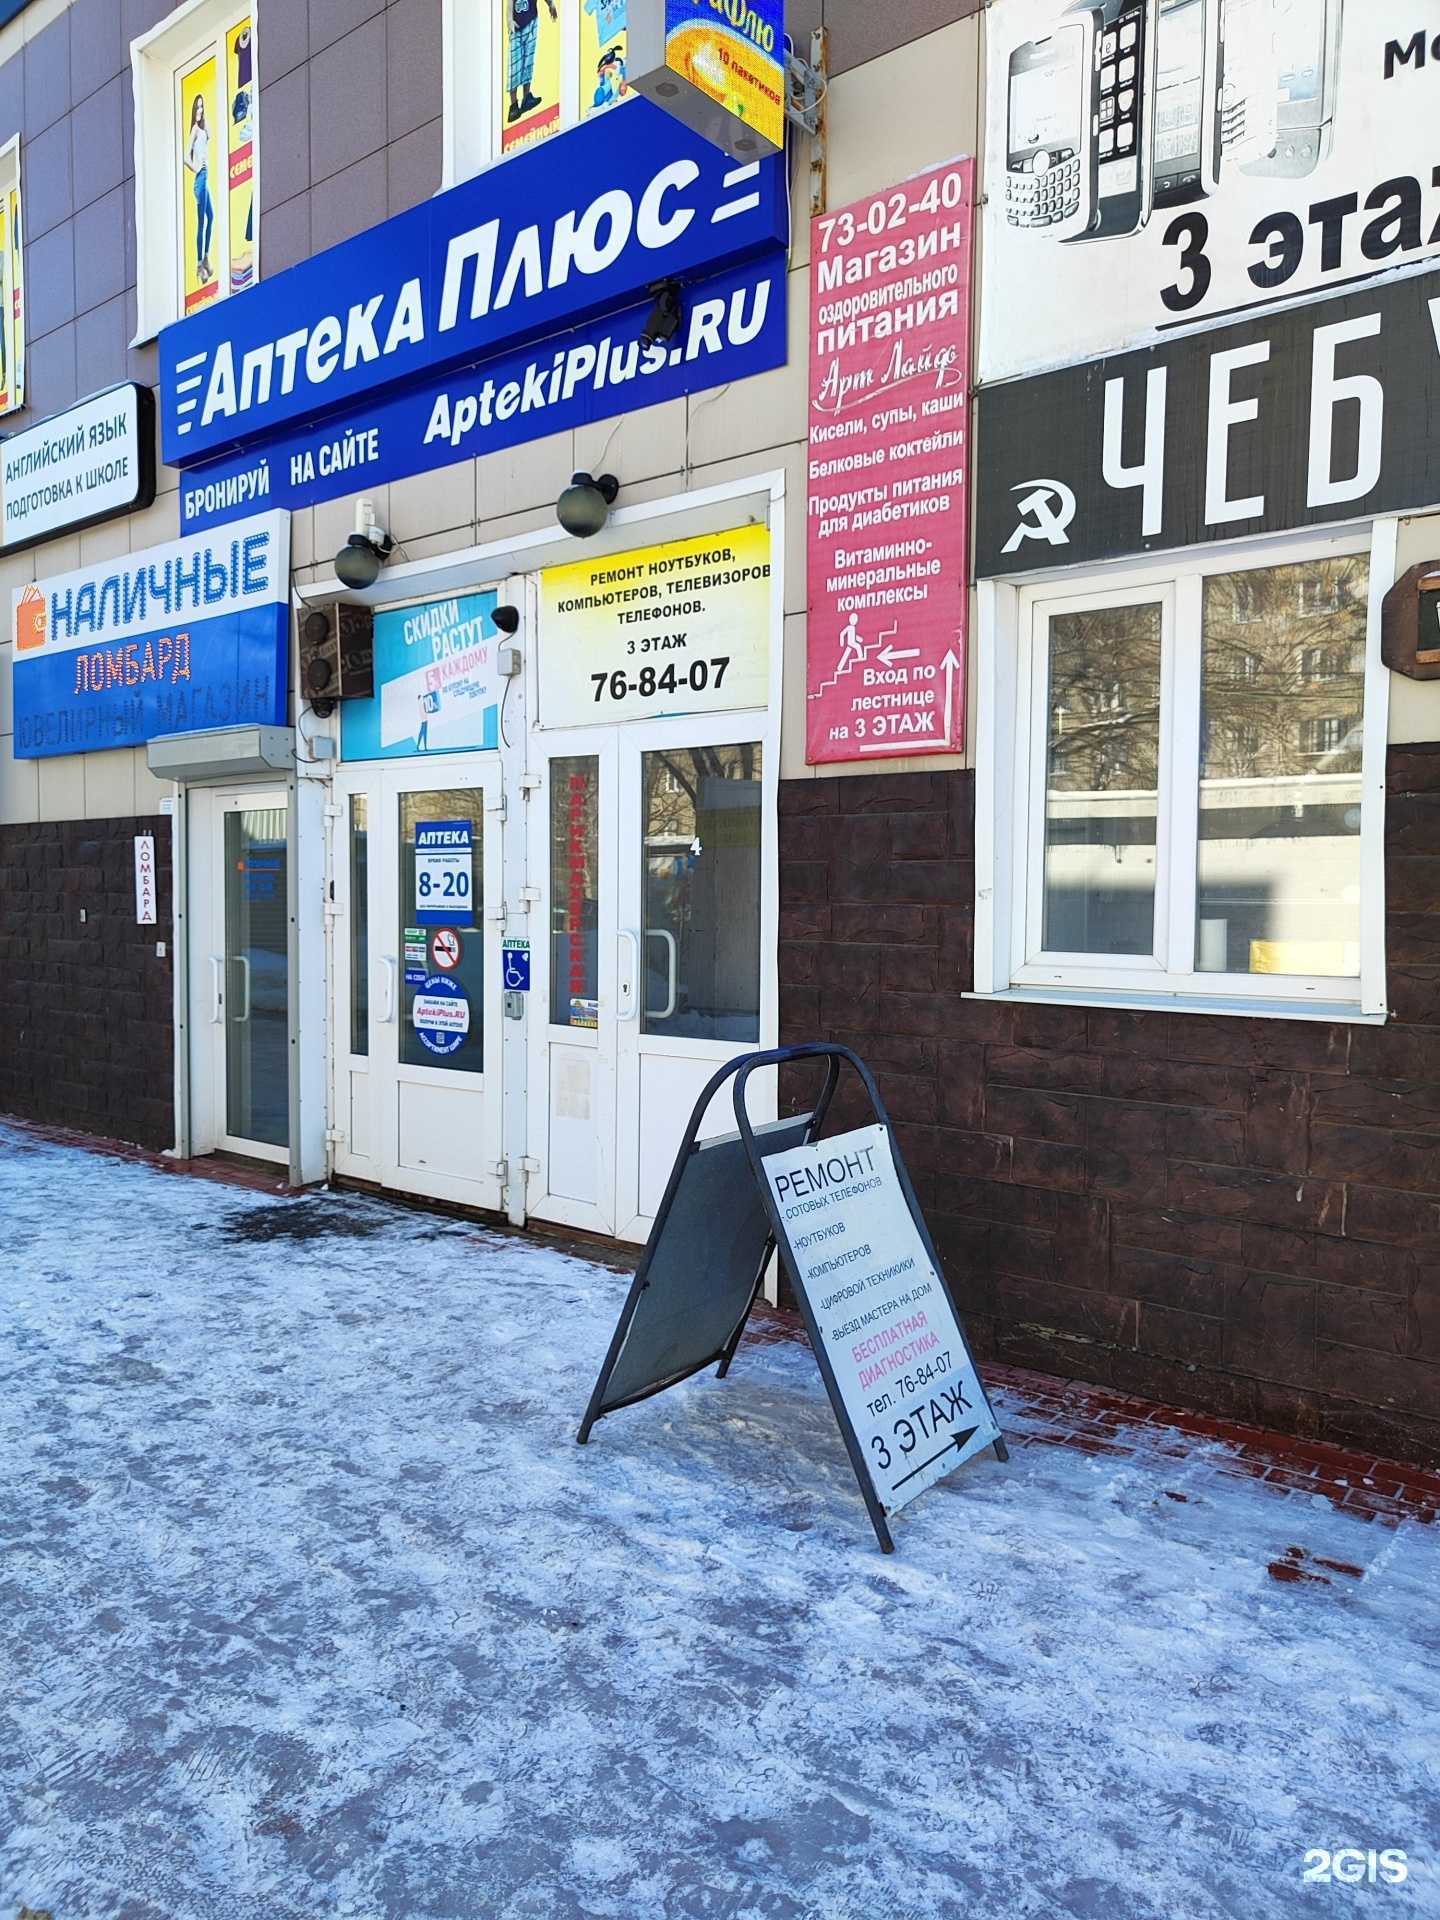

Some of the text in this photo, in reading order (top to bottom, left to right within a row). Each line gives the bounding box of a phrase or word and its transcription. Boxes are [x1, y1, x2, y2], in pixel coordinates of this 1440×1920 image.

[719, 47, 730, 66] 10
[818, 172, 962, 253] 73-02-40
[818, 222, 961, 294] Магазин
[1159, 164, 1440, 312] 3 эта
[818, 264, 958, 325] оздоровительного
[817, 289, 959, 356] питания
[185, 279, 772, 520] БРОНИРУЙ НА САЙТЕ AptekiPlus.RU
[818, 357, 874, 416] Арт
[809, 392, 964, 445] Кисели, супы, каши
[6, 412, 127, 485] АНГЛИЙСКИЙ ЯЗЫК
[809, 430, 964, 480] Белковые коктейли
[7, 456, 129, 521] ПОДГОТОВКА К ШКОЛЕ
[809, 468, 963, 517] Продукты питания
[818, 495, 950, 539] для диабетиков
[590, 548, 736, 586] РЕМОНТ НОУТБУКОВ,
[826, 558, 941, 592] минеральные
[834, 538, 932, 569] Витаминно-
[51, 531, 271, 641] НАЛИЧНЫЕ
[558, 564, 771, 613] КОМПЬЮТЕРОВ, ТЕЛЕВИЗОРОВ
[837, 582, 928, 612] комплексы
[404, 599, 460, 646] СКИДКИ
[617, 600, 706, 624] ТЕЛЕФОНОВ.
[73, 632, 190, 695] ЛОМБАРД
[431, 616, 483, 662] РАСТУТ
[441, 646, 489, 681] КАЖДОМУ
[626, 633, 688, 656] 3 ЭТАЖ
[156, 674, 270, 725] МАГАЗИН
[590, 657, 731, 703] 76-84-07
[851, 688, 935, 712] лестнице
[863, 665, 936, 687] Вход по
[829, 710, 935, 741] на 3 ЭТАЖ
[418, 830, 469, 845] АПТЕКА
[690, 837, 703, 856] 4
[140, 840, 152, 921] ЛОМБАРД
[419, 871, 469, 897] 8-20
[502, 939, 530, 949] АПТЕКА
[774, 1145, 874, 1203] РЕМОНТ
[829, 1176, 883, 1202] ТЕЛЕФОНОВ
[861, 1300, 900, 1326] МАСТЕРА
[899, 1293, 912, 1307] НА
[911, 1282, 933, 1300] ДОМ
[851, 1310, 929, 1364] БЕСПЛАТНАЯ
[858, 1330, 941, 1391] ДИАГНОСТИКА
[866, 1350, 954, 1418] тел. 76-84-07
[871, 1380, 973, 1470] 3 ЭТАЖ
